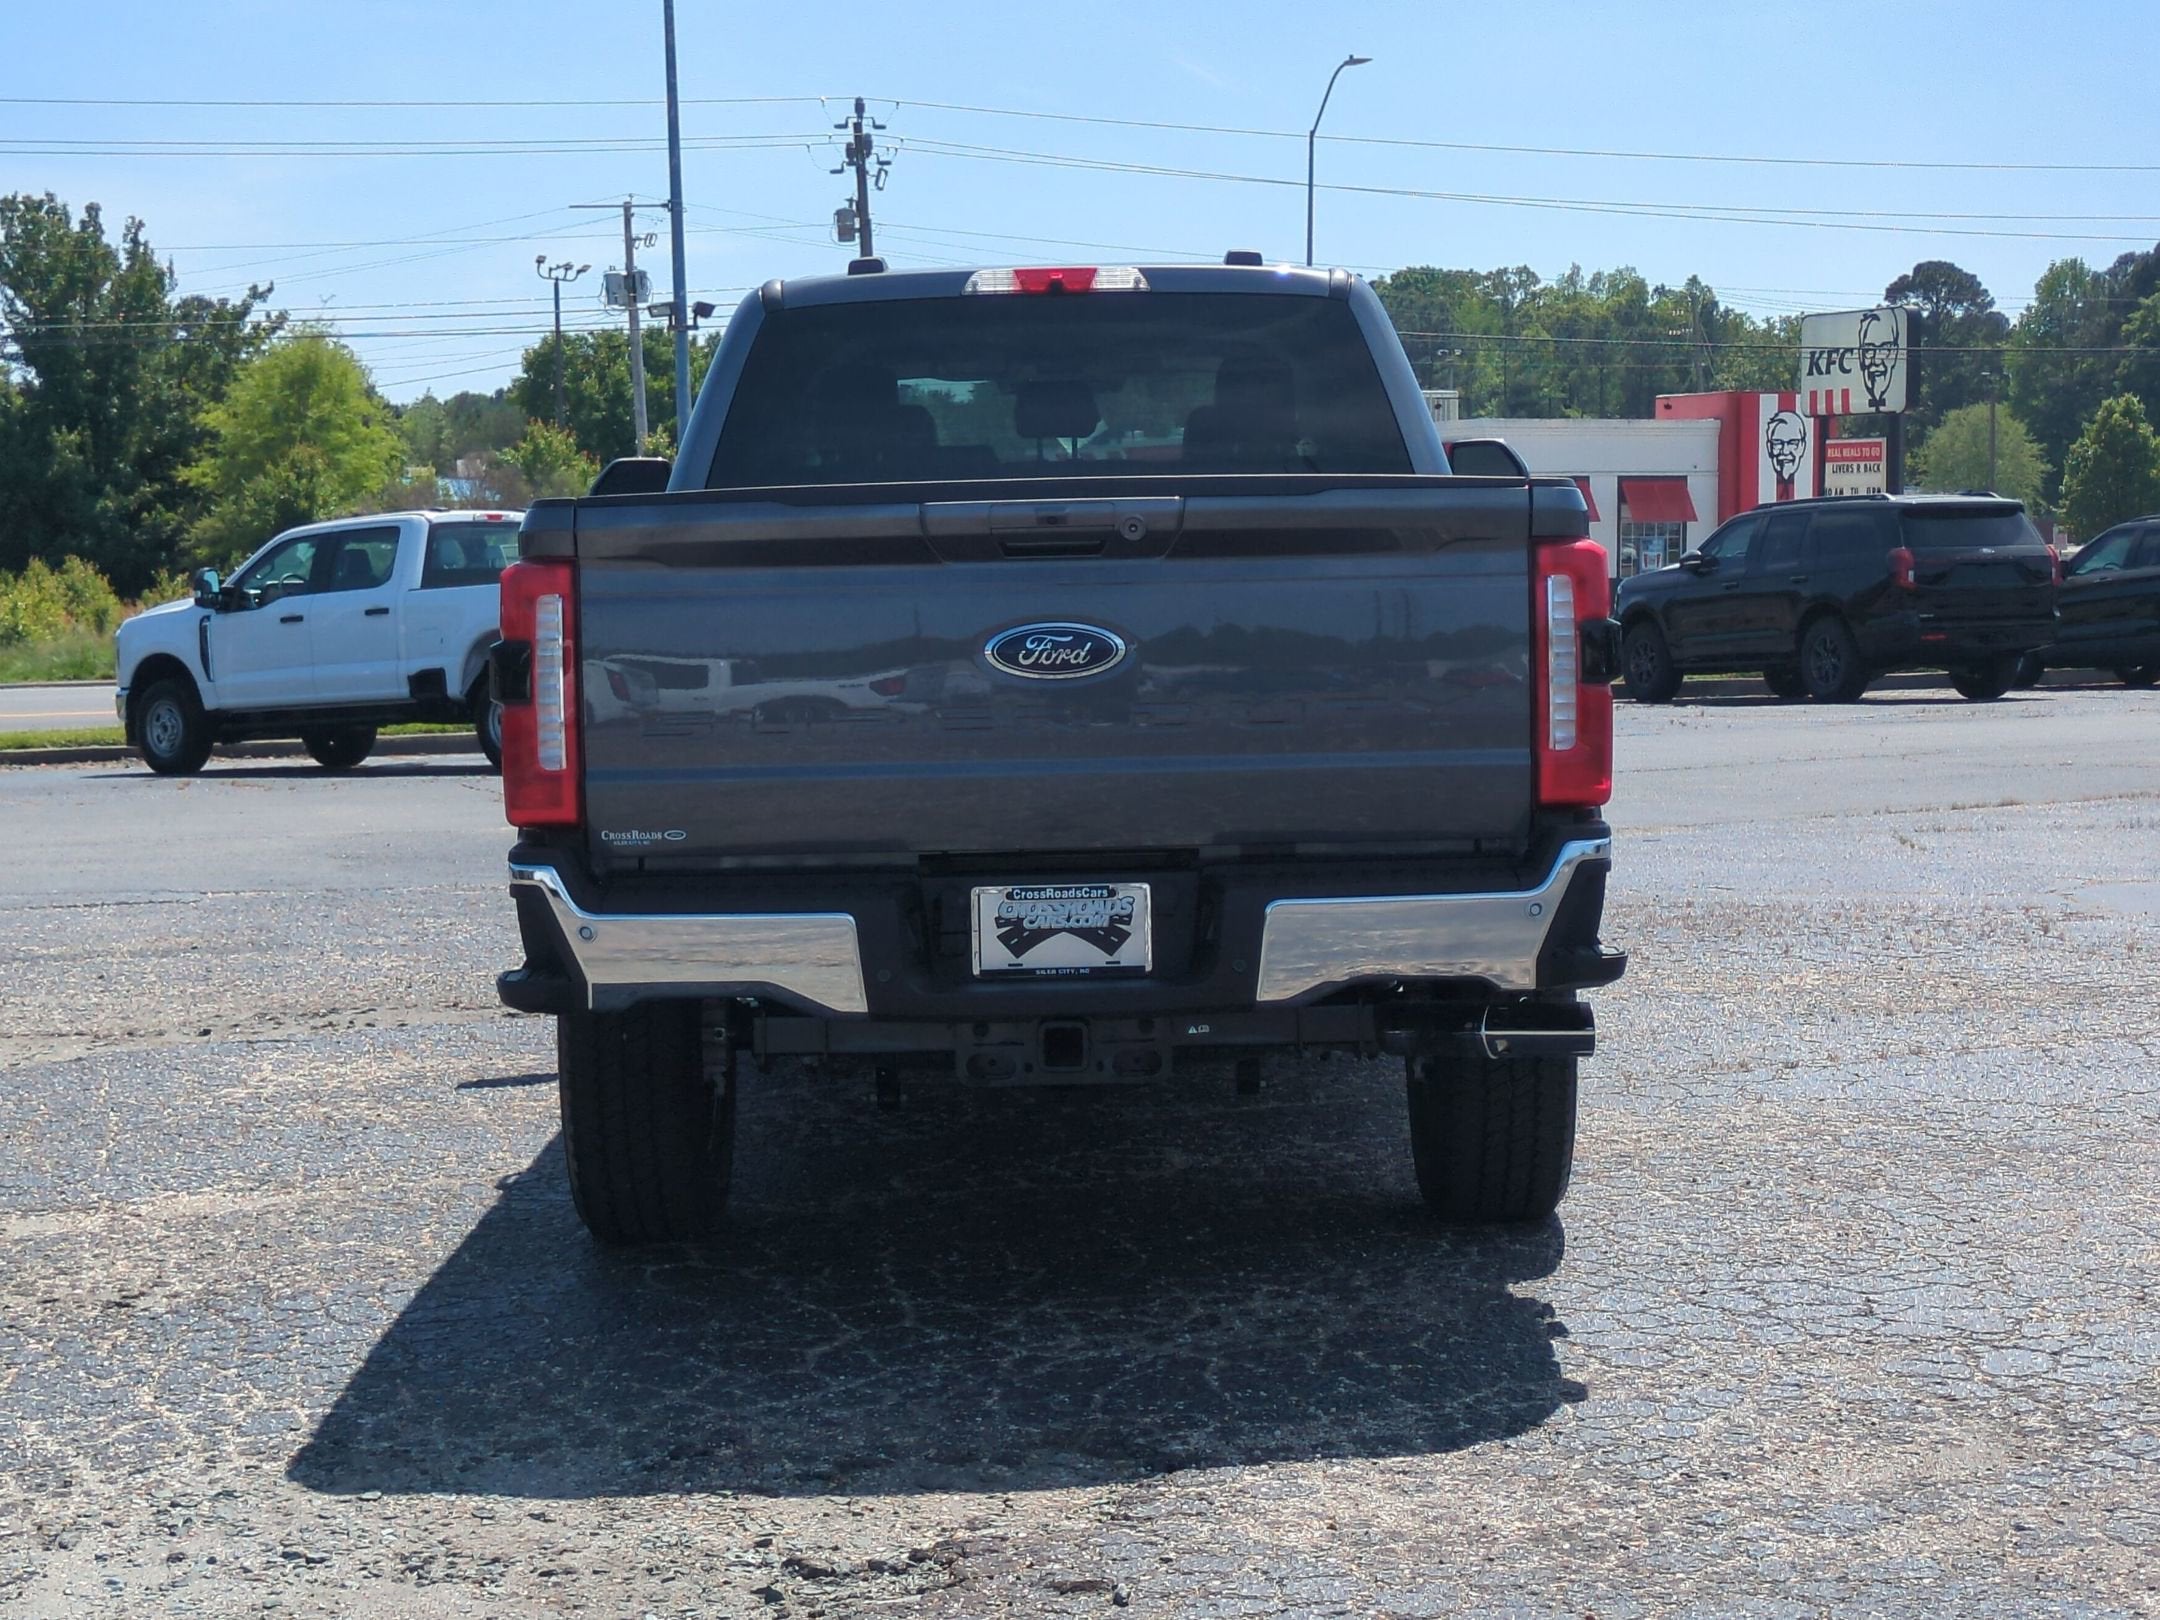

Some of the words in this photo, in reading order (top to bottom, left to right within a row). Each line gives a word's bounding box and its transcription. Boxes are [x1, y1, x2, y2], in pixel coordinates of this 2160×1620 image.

[1806, 349, 1854, 376] KFC
[1862, 447, 1870, 457] TO
[1832, 464, 1854, 474] LIVERS
[1863, 463, 1881, 473] BACK
[1018, 634, 1092, 665] Ford
[1013, 888, 1108, 900] CrossRoadsCars
